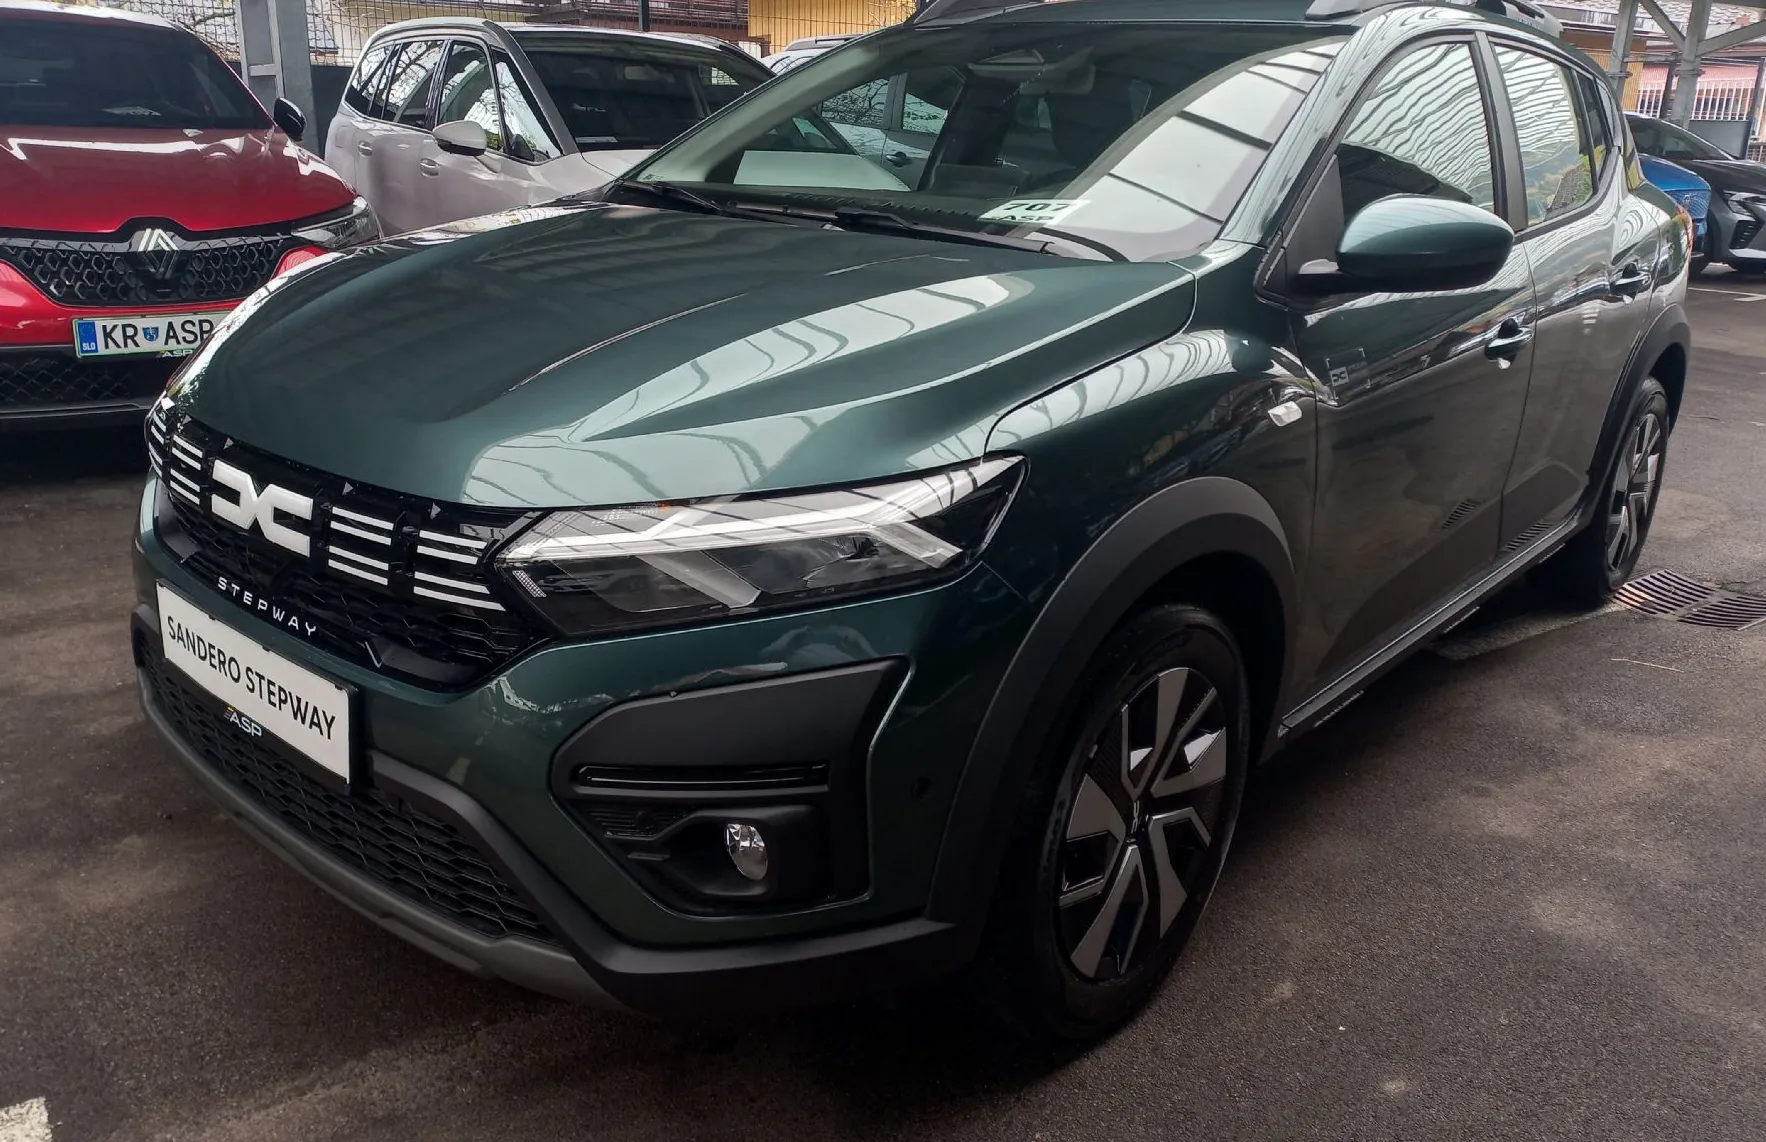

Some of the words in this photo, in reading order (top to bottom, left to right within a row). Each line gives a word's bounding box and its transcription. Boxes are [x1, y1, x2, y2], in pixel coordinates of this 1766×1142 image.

[82, 342, 96, 351] SLO
[102, 323, 140, 350] KR
[164, 319, 214, 346] ASP
[162, 349, 194, 358] ASP
[217, 577, 316, 636] STEPWAY
[167, 615, 241, 684] SANDERO
[245, 665, 336, 740] STEPWAY
[229, 711, 262, 737] ASP
